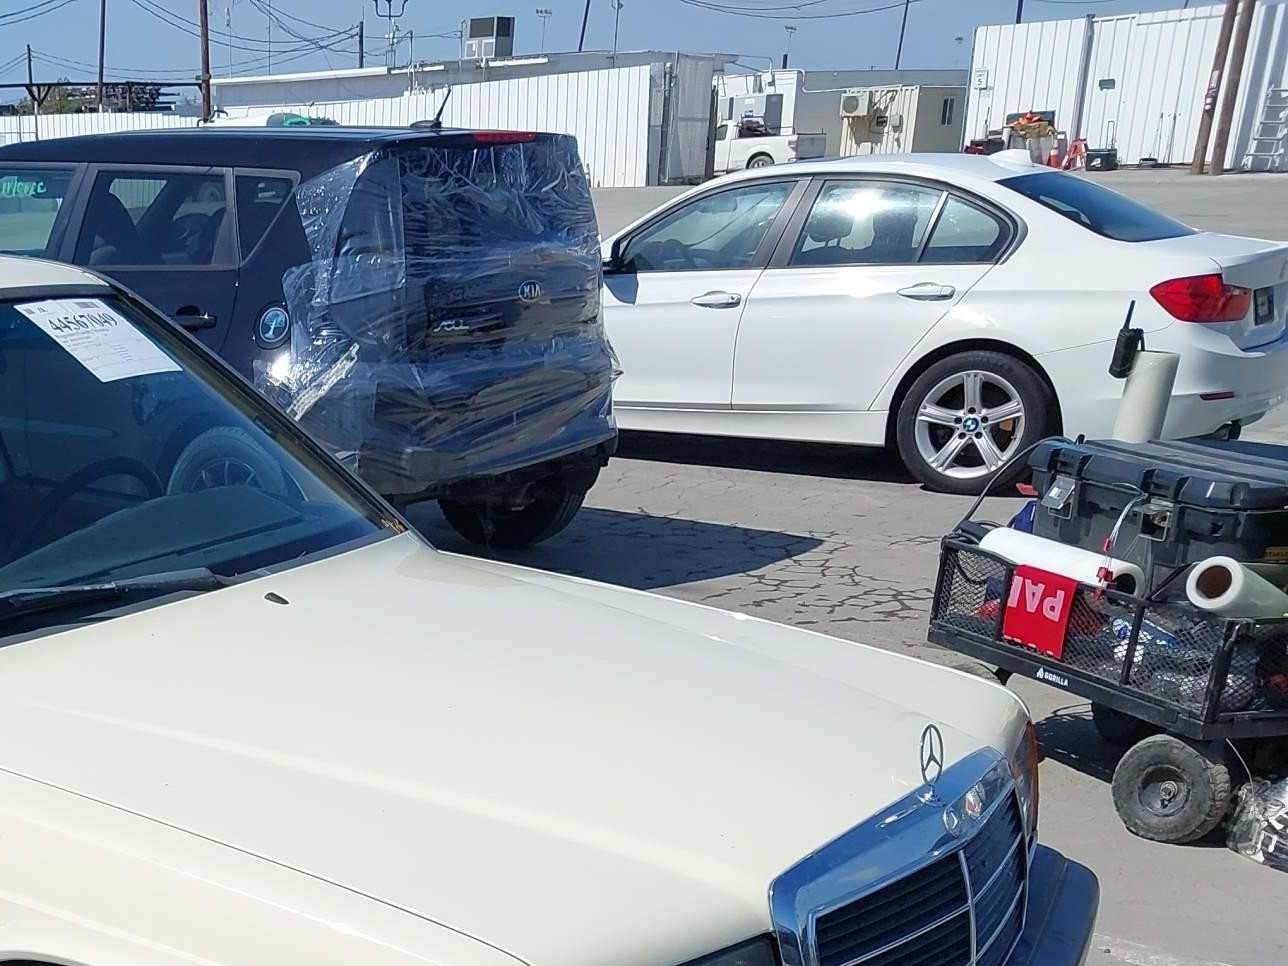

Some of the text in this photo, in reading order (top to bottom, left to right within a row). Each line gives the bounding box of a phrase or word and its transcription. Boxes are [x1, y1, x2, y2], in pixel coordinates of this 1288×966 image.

[523, 284, 541, 297] KIA
[48, 312, 118, 333] 44567049
[1044, 672, 1069, 687] GORILLA
